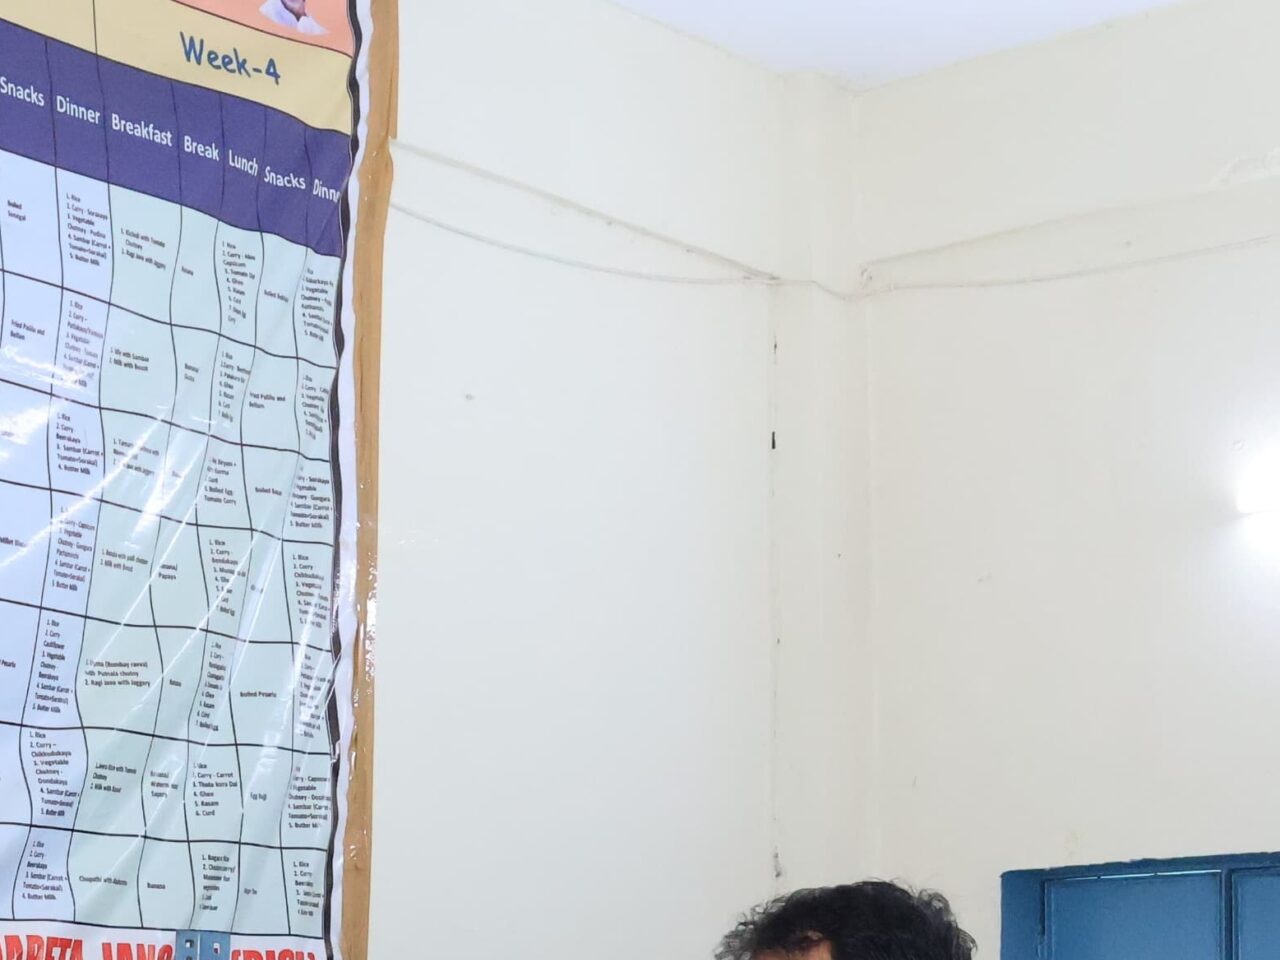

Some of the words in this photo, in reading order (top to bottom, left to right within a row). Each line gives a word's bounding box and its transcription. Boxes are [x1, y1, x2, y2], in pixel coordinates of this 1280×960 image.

[179, 31, 281, 85] Week-4
[0, 76, 44, 106] Snacks
[56, 95, 100, 123] Dinner
[111, 113, 172, 146] Breakfast
[184, 135, 219, 160] Break
[228, 149, 258, 176] Lunch
[263, 166, 305, 189] Snacks
